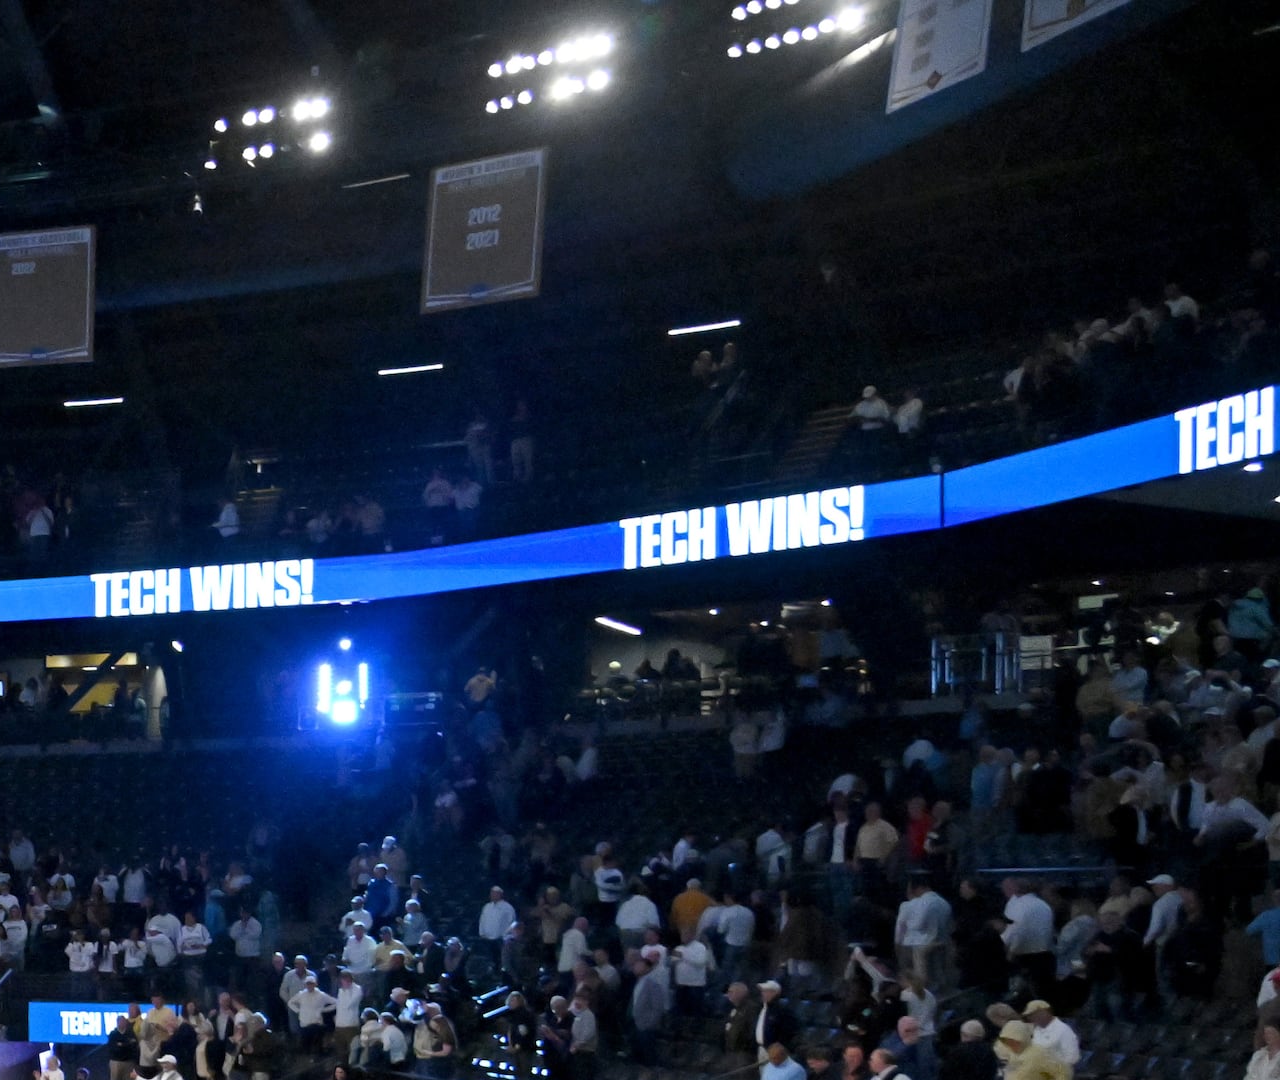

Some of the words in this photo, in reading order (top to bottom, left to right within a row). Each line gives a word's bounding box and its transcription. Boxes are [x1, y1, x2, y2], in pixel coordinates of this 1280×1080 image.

[1174, 386, 1274, 474] TECH
[619, 506, 716, 570] TECH
[725, 485, 864, 556] WINS!
[90, 568, 181, 618] TECH
[189, 558, 315, 612] WINS!
[60, 1011, 98, 1036] TECH
